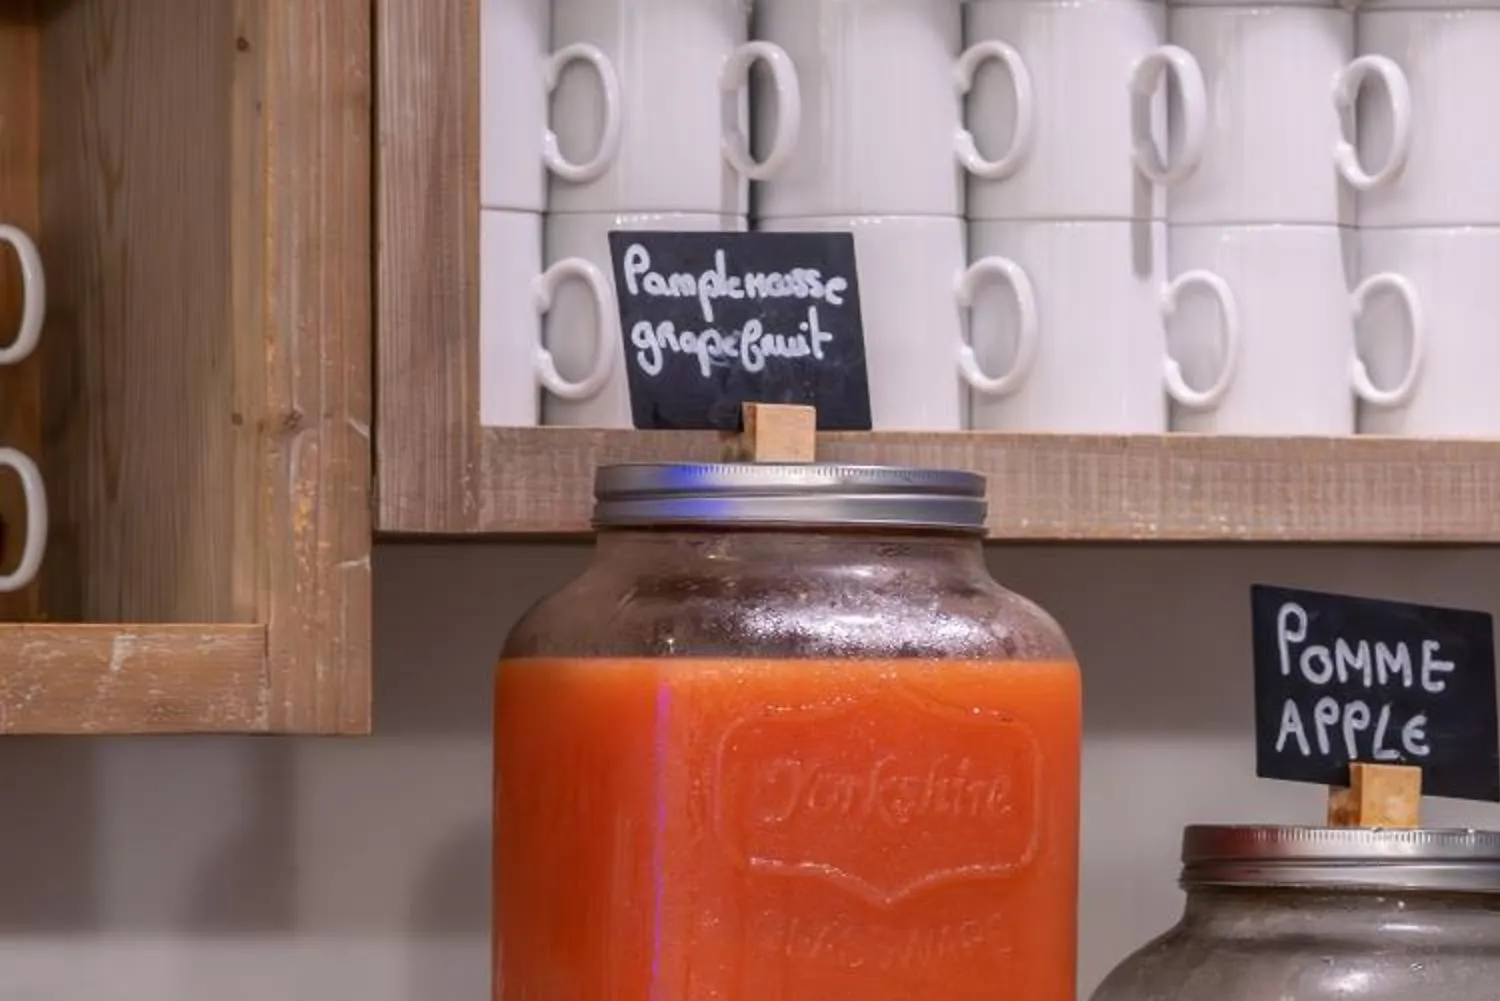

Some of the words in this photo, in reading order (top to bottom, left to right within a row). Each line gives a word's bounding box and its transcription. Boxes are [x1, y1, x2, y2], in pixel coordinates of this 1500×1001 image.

[631, 305, 834, 378] grapefruit
[1277, 602, 1456, 692] POMME
[1275, 696, 1431, 760] APPLE
